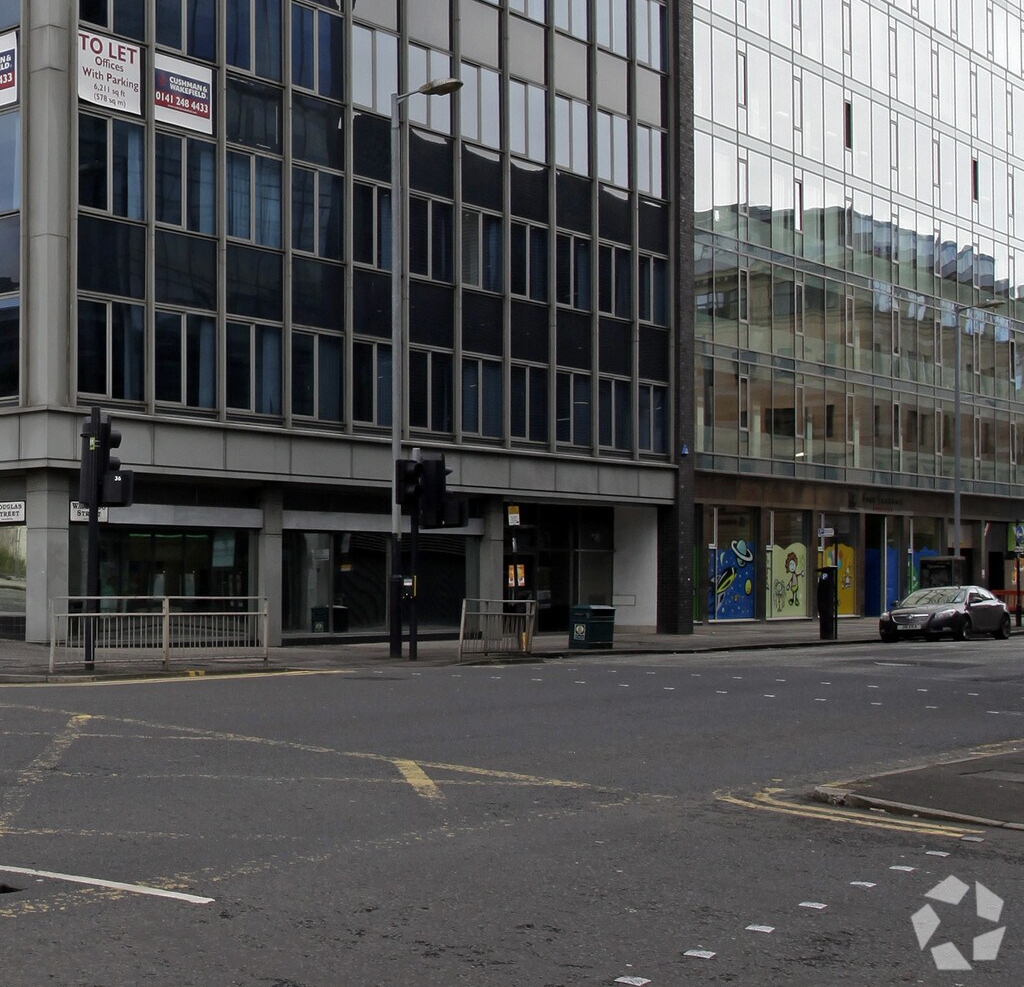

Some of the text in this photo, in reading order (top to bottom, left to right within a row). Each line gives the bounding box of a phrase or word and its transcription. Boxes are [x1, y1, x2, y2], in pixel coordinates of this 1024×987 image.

[78, 33, 137, 64] TO LET
[95, 56, 124, 72] Offices
[82, 66, 139, 93] With Parking
[169, 76, 202, 91] CUSHMAN
[93, 83, 110, 93] 6,211
[169, 83, 207, 99] WAKEFIELD
[156, 91, 173, 104] 0141
[176, 96, 190, 108] 248
[191, 101, 209, 113] 4433
[77, 509, 101, 517] STRT
